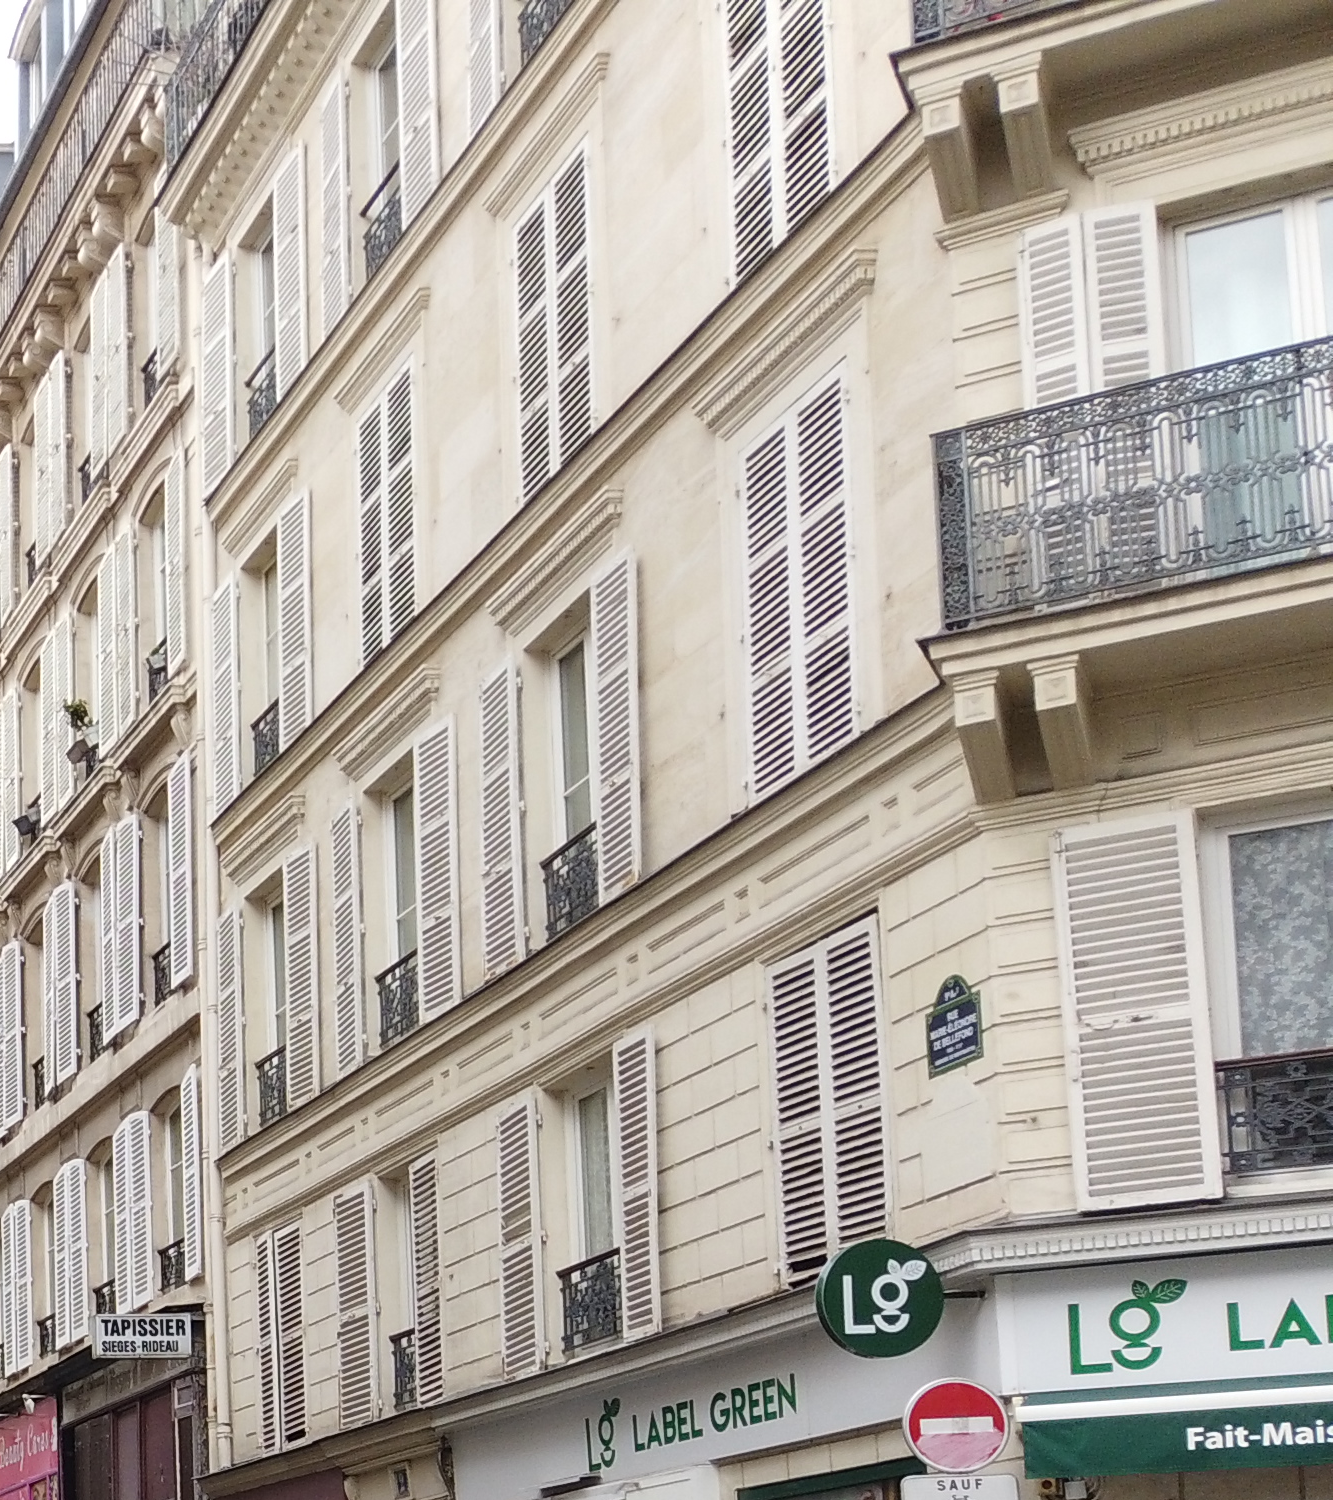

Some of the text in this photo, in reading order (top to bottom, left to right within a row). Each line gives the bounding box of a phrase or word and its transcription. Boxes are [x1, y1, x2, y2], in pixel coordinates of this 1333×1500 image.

[101, 1318, 186, 1337] TAPISSIER
[1226, 1294, 1333, 1351] LA
[101, 1340, 179, 1353] SIEGES-RIDEAU
[632, 1400, 703, 1453] LABEL
[710, 1373, 797, 1433] GREEN
[27, 1423, 49, 1457] Cares
[937, 1479, 983, 1491] SAUF
